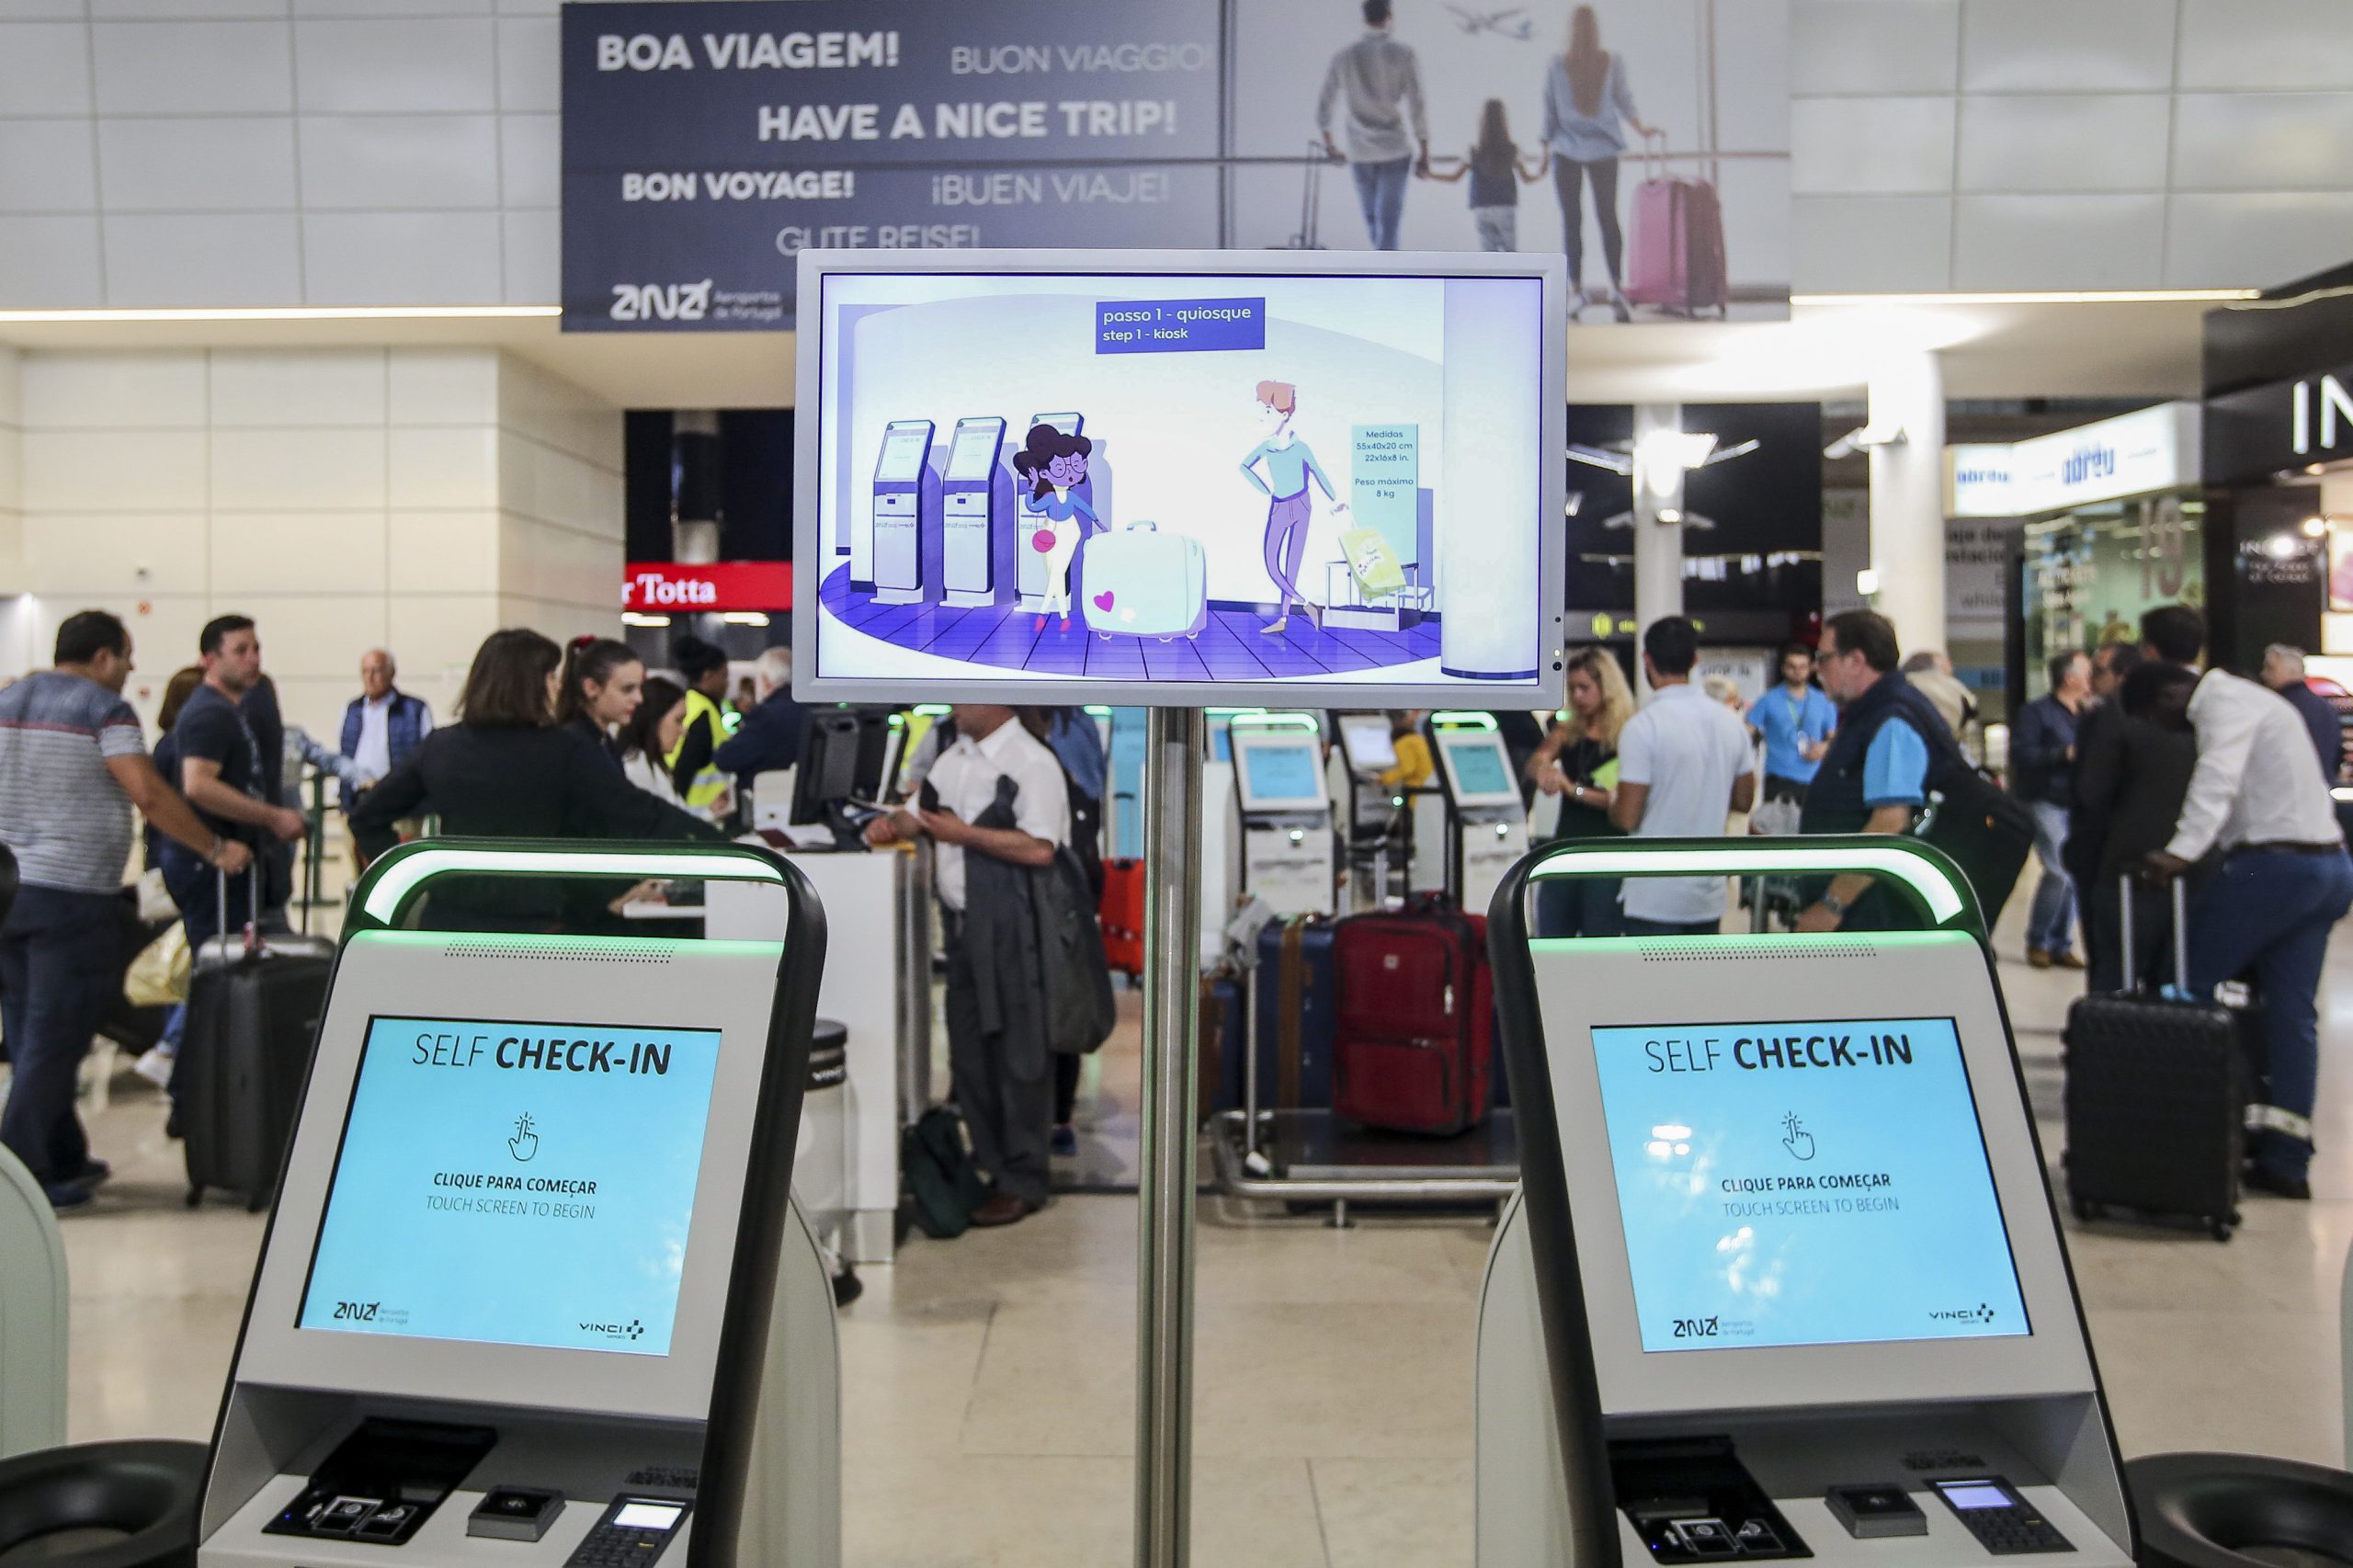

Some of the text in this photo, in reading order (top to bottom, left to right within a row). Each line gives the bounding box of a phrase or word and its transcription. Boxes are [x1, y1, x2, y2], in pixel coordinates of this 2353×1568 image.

[597, 30, 900, 71] BOA VIAGEM!
[950, 45, 1051, 74] BUON
[758, 100, 1177, 141] HAVE A NICE TRIP!
[622, 171, 855, 201] BON VOYAGE!
[1051, 172, 1170, 203] VIAJE!
[776, 226, 870, 256] GUTE
[1104, 310, 1152, 324] passo
[1155, 308, 1162, 320] 1
[1176, 307, 1252, 323] quiosque
[1103, 330, 1133, 343] step
[1136, 329, 1142, 340] 1
[1154, 328, 1188, 340] kiosk
[1357, 442, 1396, 450] 55x40x20
[1366, 430, 1404, 438] Medidas
[1383, 490, 1394, 498] kg
[637, 574, 717, 604] Totta
[412, 1033, 672, 1075] SELF CHECK-IN
[1644, 1034, 1914, 1073] SELF CHECK-IN
[434, 1172, 597, 1198] CLIQUE PARA COMEÇAR
[1722, 1173, 1892, 1193] CLIQUE PARA COMEÇAR
[426, 1195, 596, 1220] TOUCH SCREEN TO BEGIN
[1722, 1197, 1899, 1217] TOUCH SCREEN TO BEGIN
[1928, 1311, 1973, 1319] VINCI
[579, 1323, 622, 1334] VINCI
